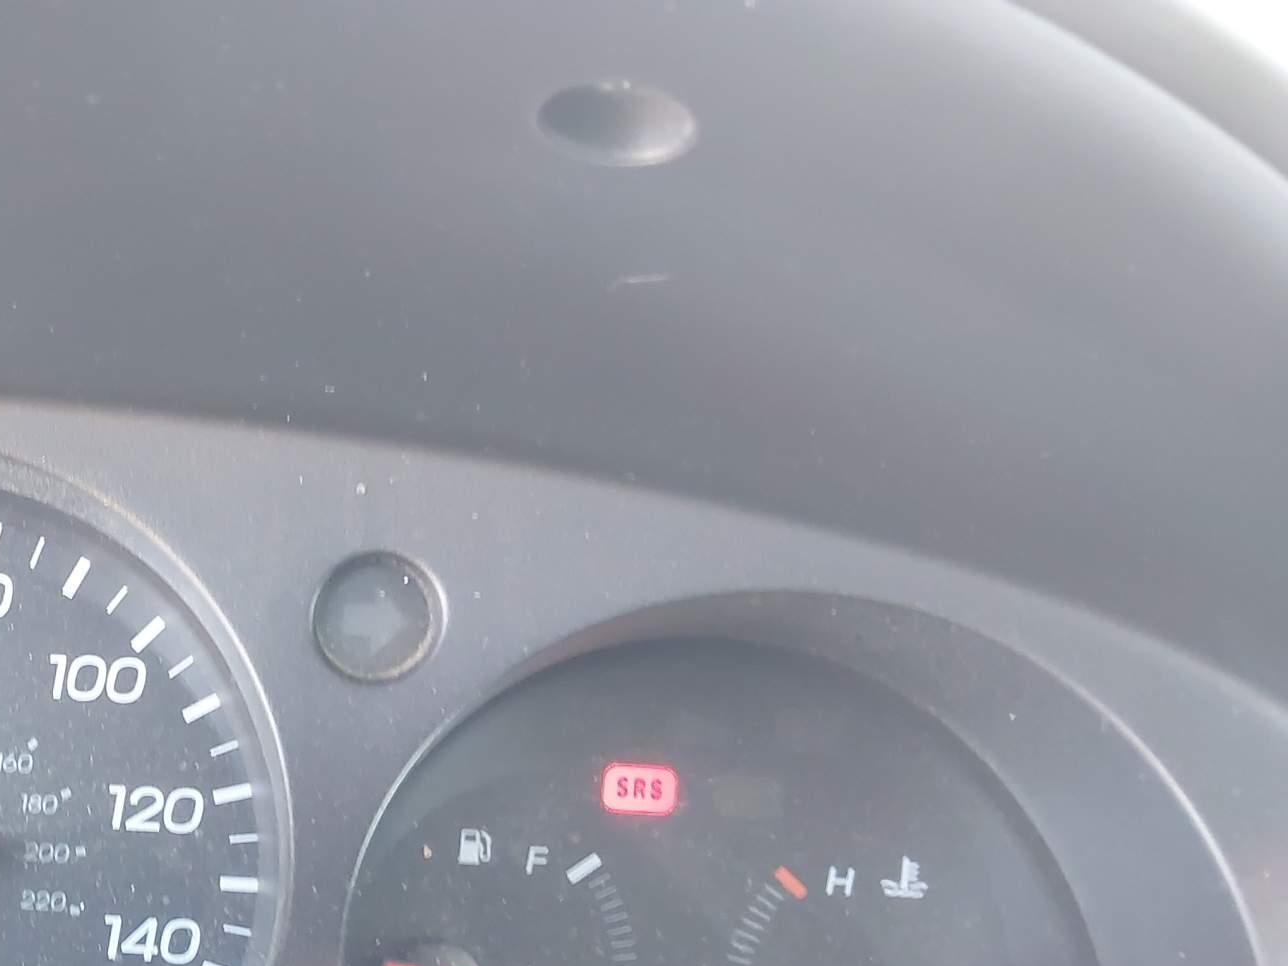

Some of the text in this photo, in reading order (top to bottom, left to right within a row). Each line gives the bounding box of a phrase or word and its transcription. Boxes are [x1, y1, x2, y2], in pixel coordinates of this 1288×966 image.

[49, 654, 146, 703] 100
[617, 776, 663, 801] SRS
[22, 793, 58, 815] 180
[109, 784, 204, 834] 120
[25, 841, 70, 864] 200
[526, 846, 549, 875] F
[826, 866, 855, 896] H
[20, 889, 66, 912] 220
[104, 914, 201, 963] 140
